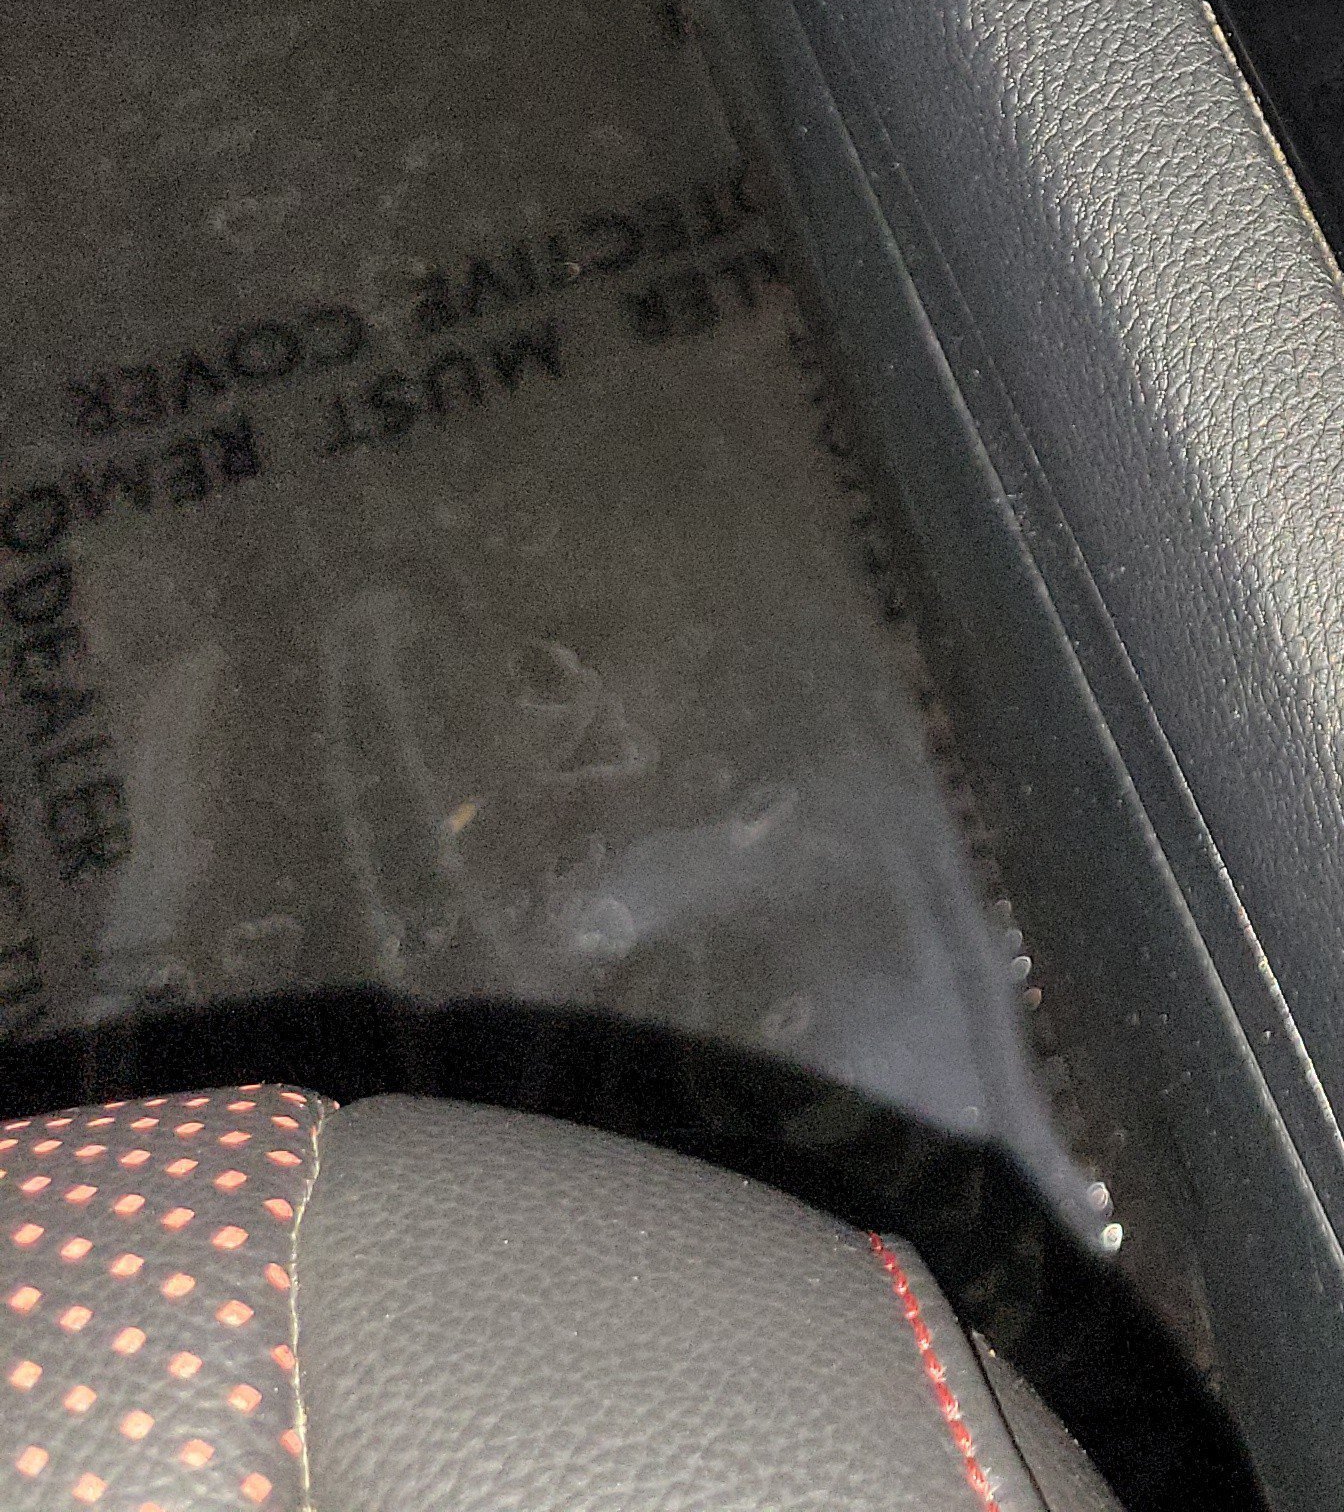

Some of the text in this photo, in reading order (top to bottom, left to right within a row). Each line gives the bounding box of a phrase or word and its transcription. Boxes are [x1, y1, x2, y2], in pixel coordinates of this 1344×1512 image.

[68, 302, 370, 438] COVER
[320, 316, 562, 456] MUST
[4, 558, 133, 884] DEALER
